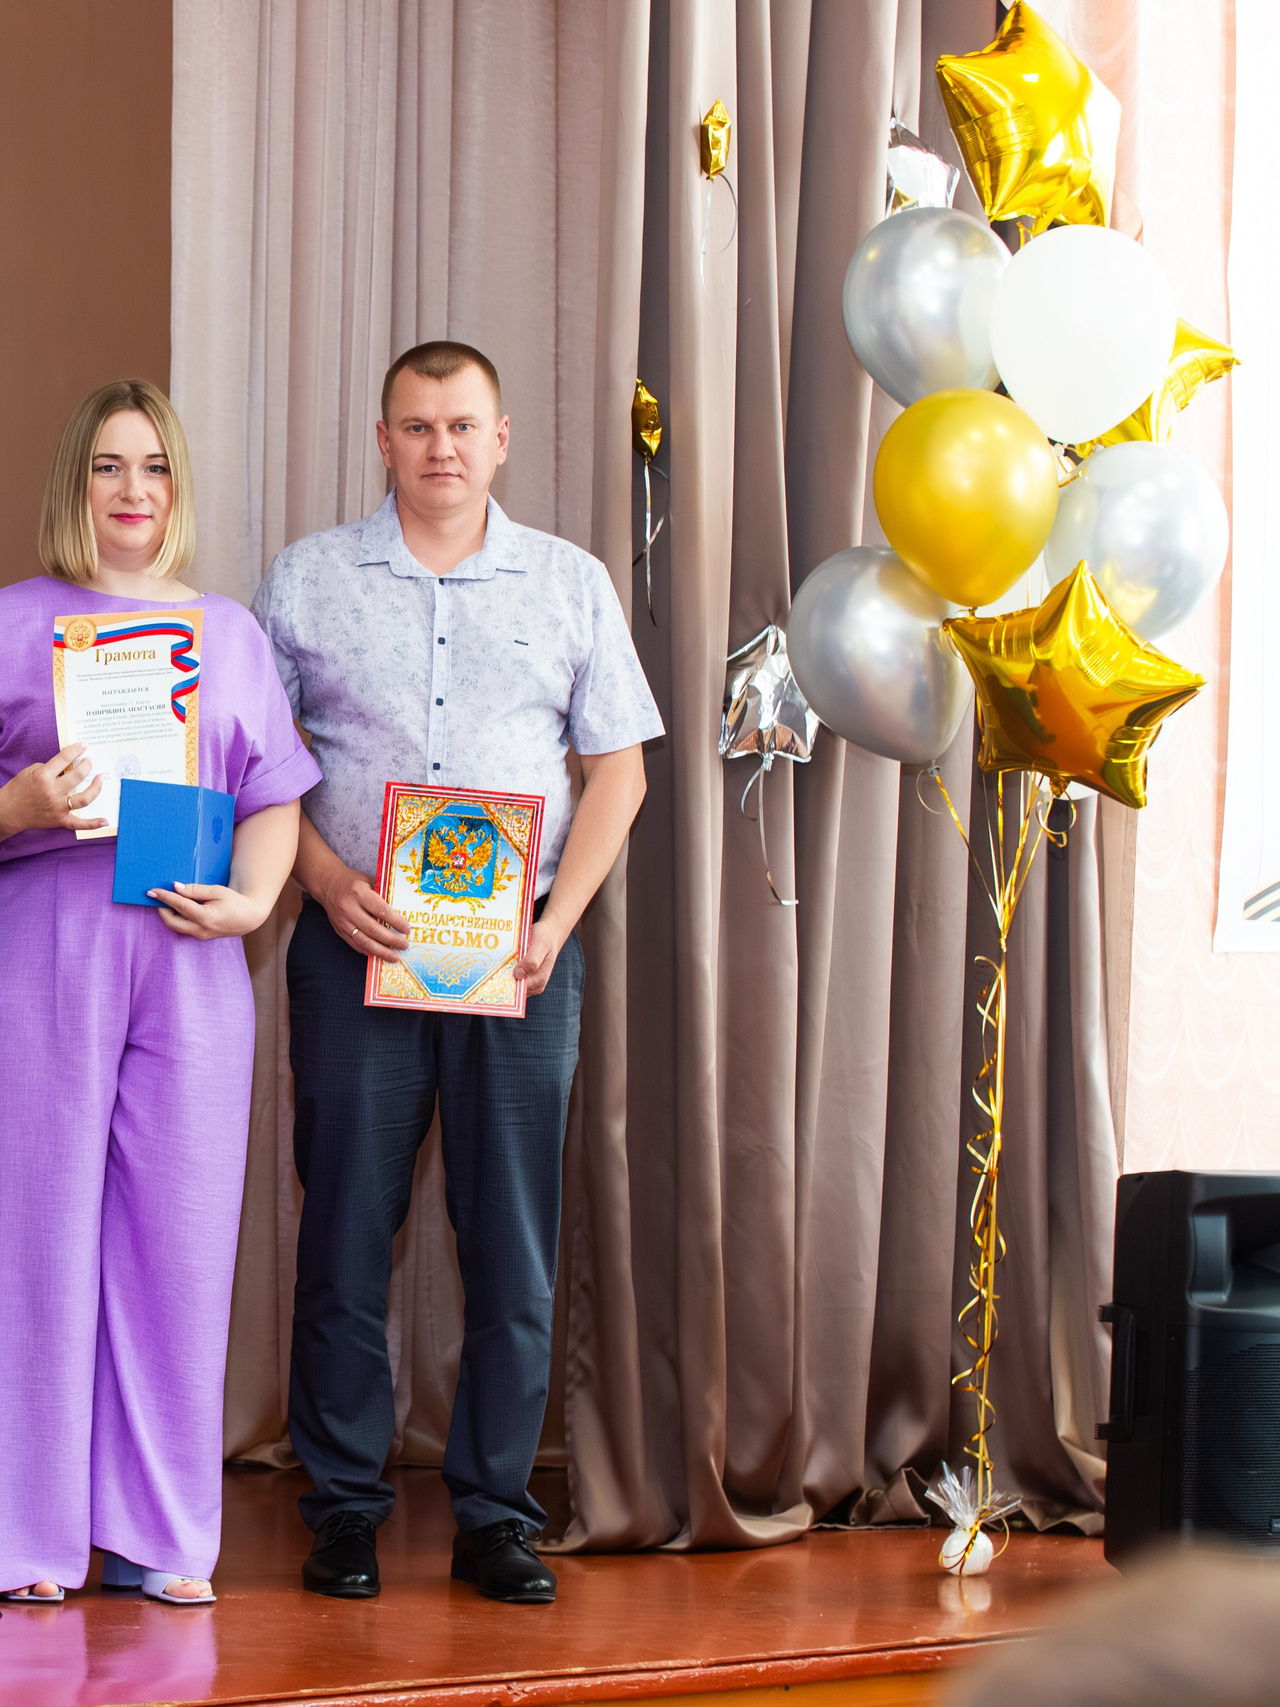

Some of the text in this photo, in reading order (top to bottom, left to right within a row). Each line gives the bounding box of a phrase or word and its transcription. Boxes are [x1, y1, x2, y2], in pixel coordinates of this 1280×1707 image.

[95, 648, 156, 665] Грамота
[102, 687, 149, 695] НАГРАЖДАЕТСЯ
[405, 926, 499, 949] ПИСЬМО
